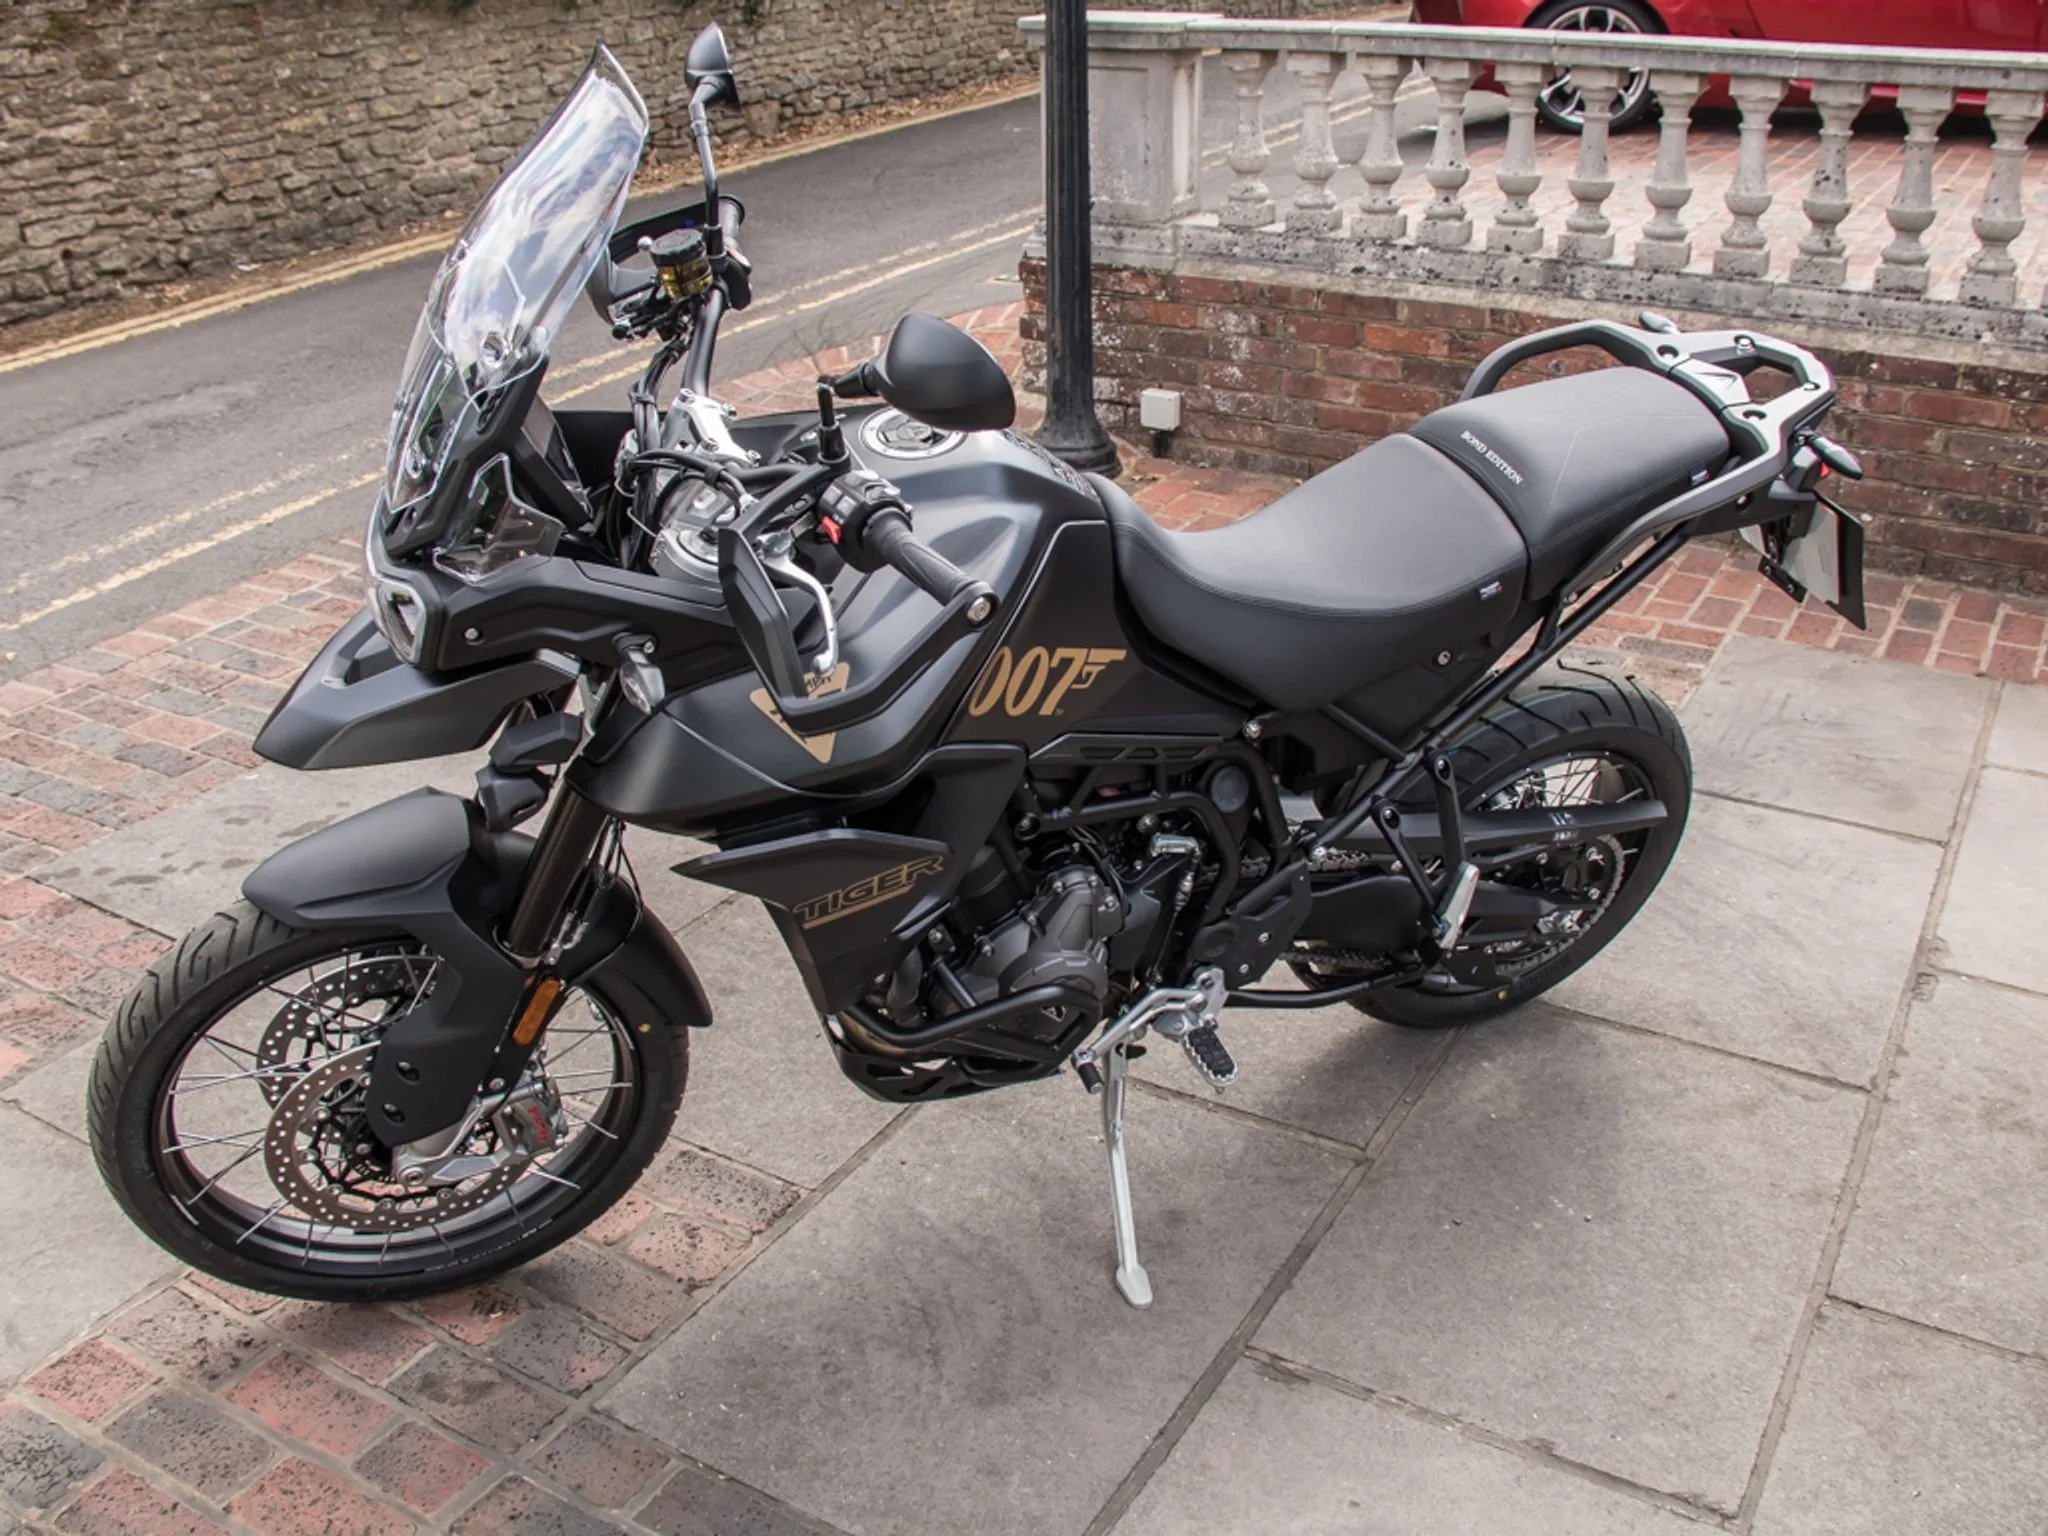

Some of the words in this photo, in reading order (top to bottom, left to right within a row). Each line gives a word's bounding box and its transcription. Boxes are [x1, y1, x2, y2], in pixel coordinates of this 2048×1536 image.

[1460, 430, 1488, 453] BOND
[1484, 449, 1524, 485] EDITION
[968, 645, 1089, 717] 007
[793, 854, 944, 922] TIGER
